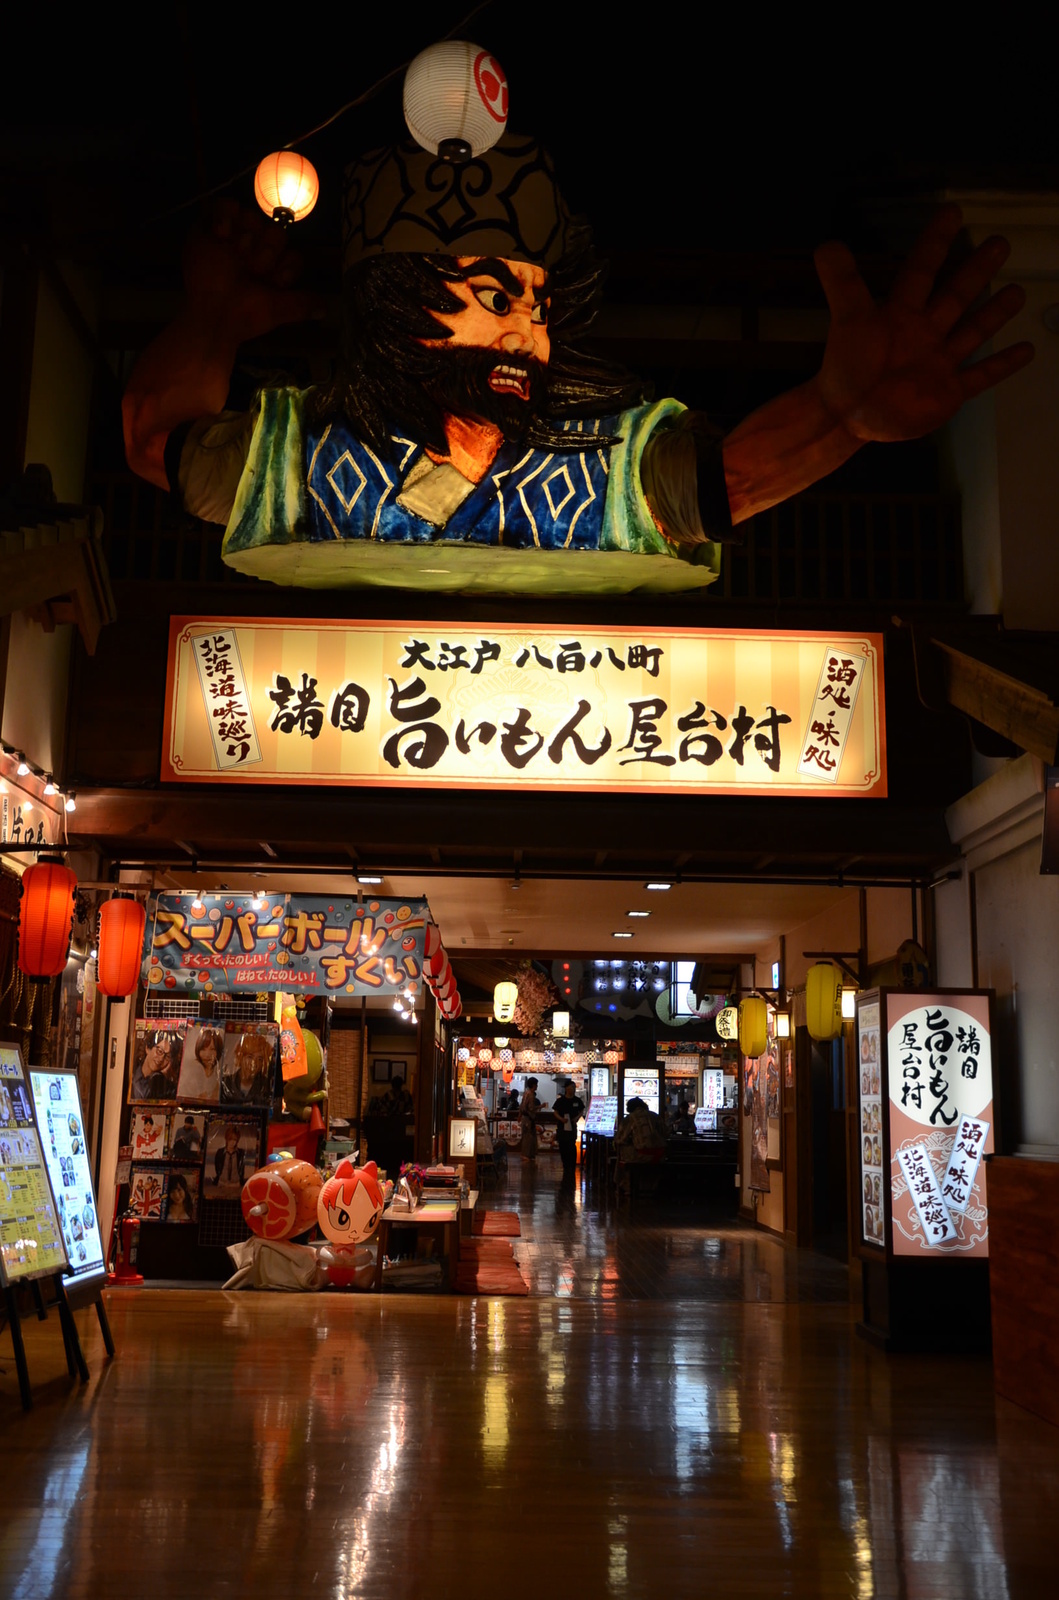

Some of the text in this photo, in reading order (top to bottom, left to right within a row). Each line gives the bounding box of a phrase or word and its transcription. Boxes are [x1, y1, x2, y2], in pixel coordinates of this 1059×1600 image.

[200, 635, 252, 763] 北海道味巡り
[401, 639, 664, 678] 大江戸 八百八町
[803, 656, 858, 772] 酒処・味処
[151, 911, 389, 957] スーパーボール
[320, 955, 420, 988] すくい
[899, 1023, 926, 1109] 屋台村
[924, 1009, 959, 1125] 旨いもん
[902, 1150, 949, 1240] 北海道味巡り
[942, 1121, 983, 1204] 酒処・味処
